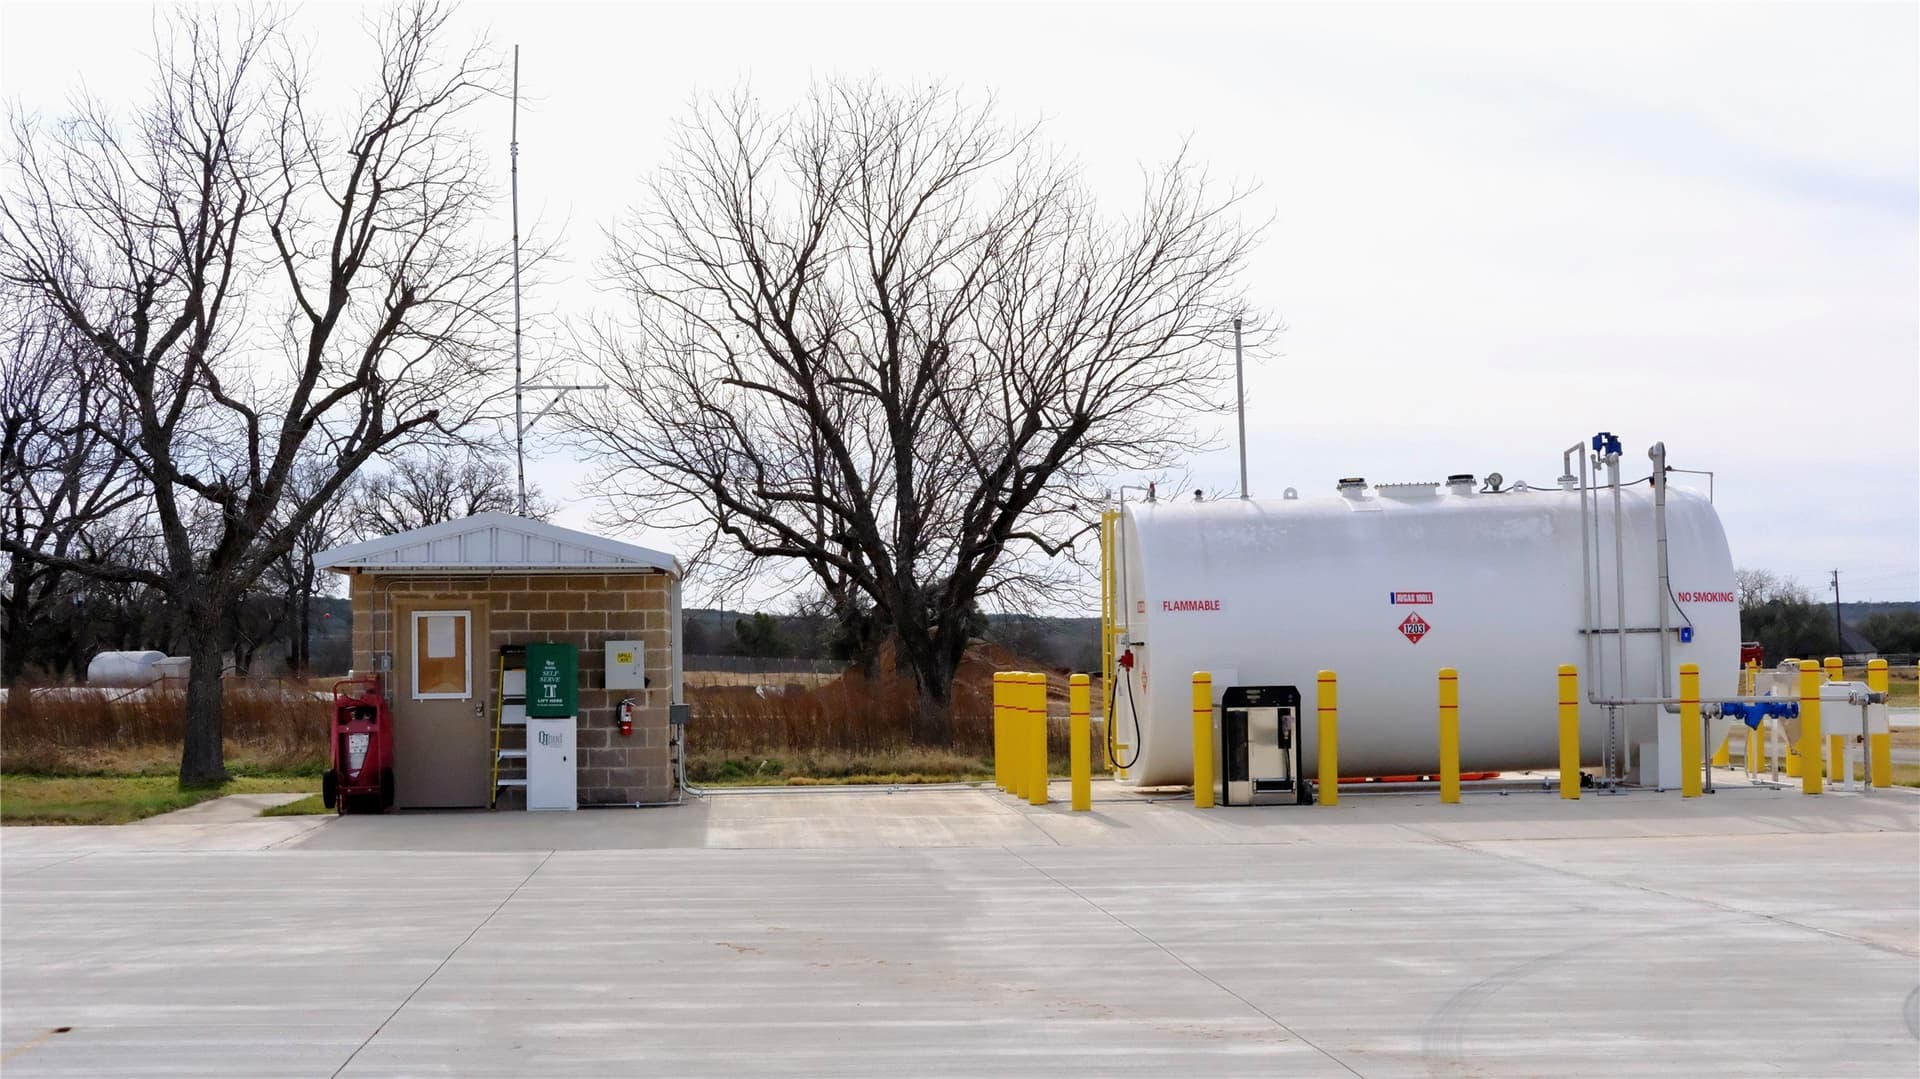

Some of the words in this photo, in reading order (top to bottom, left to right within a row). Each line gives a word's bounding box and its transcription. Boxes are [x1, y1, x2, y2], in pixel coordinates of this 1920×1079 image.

[1678, 592, 1691, 602] NO
[1693, 592, 1734, 602] SMOKING
[1163, 600, 1220, 611] FLAMMABLE
[1405, 624, 1424, 634] 1203
